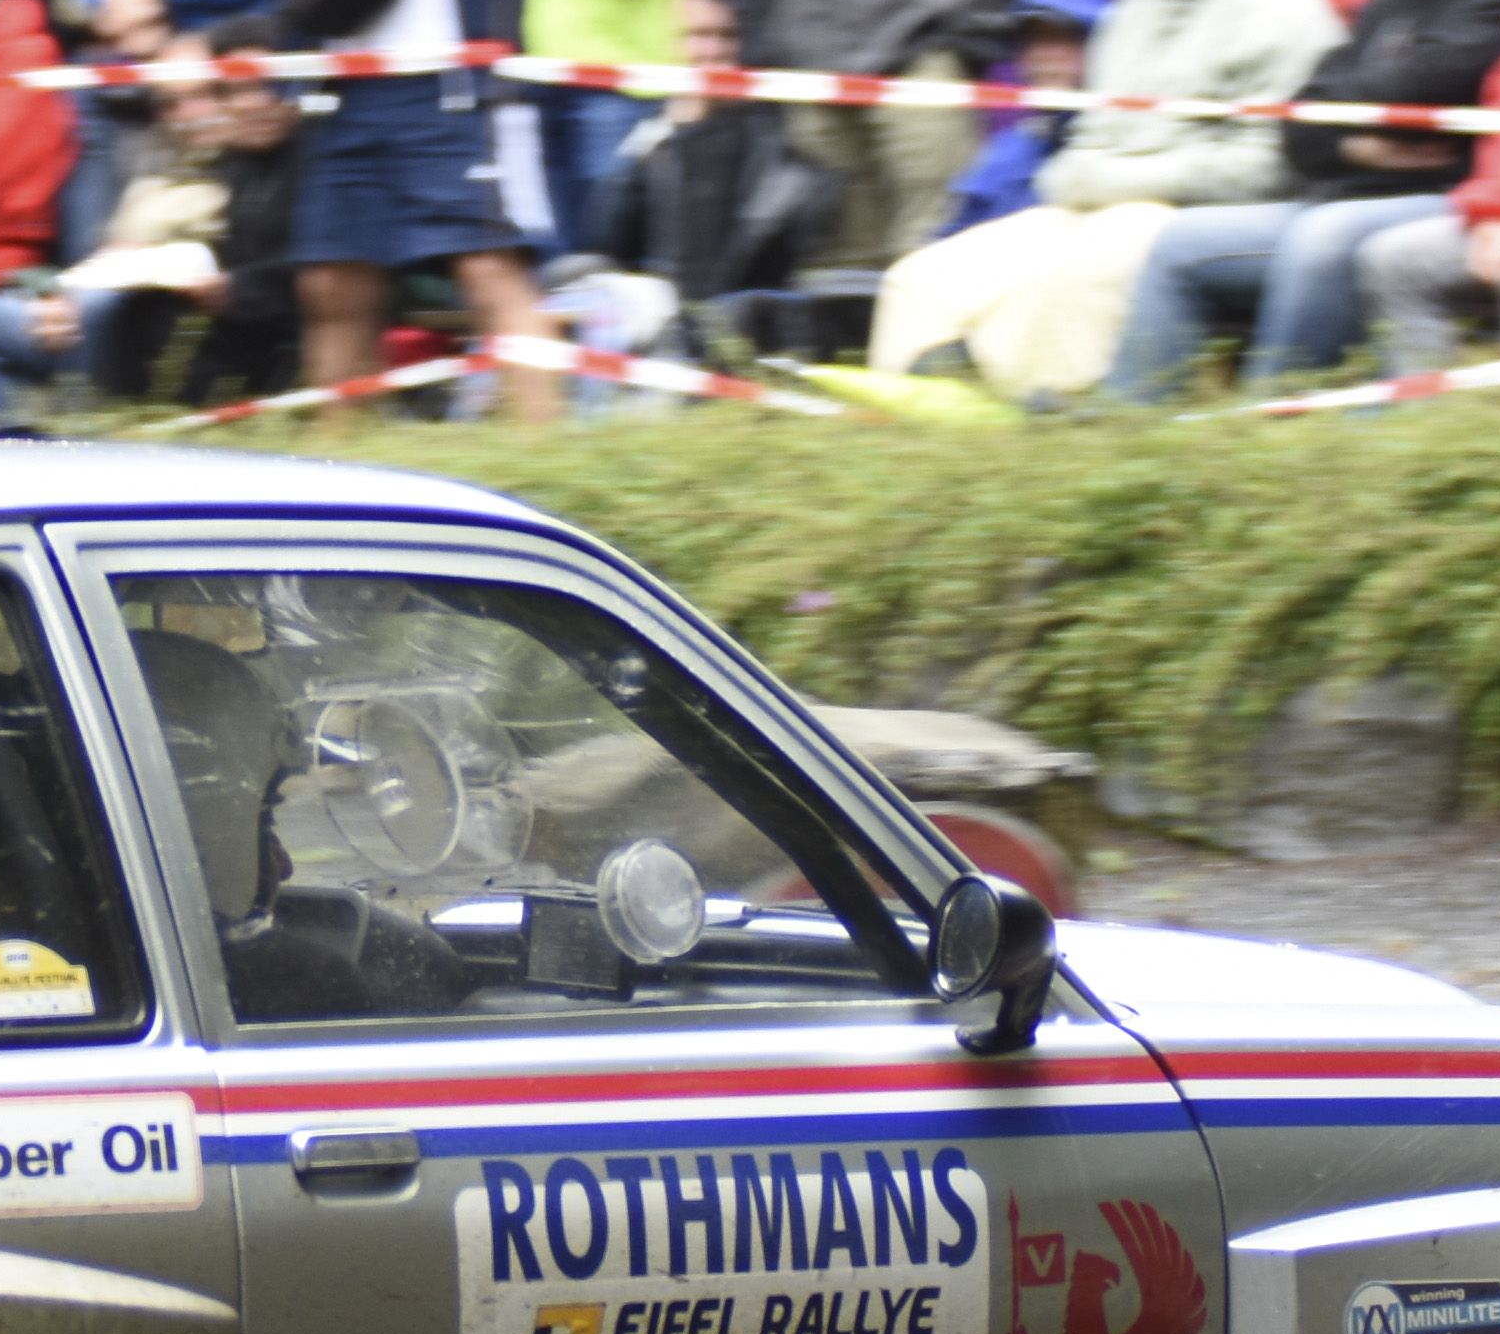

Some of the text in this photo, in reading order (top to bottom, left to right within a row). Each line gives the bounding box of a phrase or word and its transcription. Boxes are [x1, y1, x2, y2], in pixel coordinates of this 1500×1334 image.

[101, 1121, 178, 1174] Oil
[482, 1147, 980, 1282] ROTHMANS
[1026, 1241, 1054, 1277] V
[1410, 1287, 1465, 1302] winning
